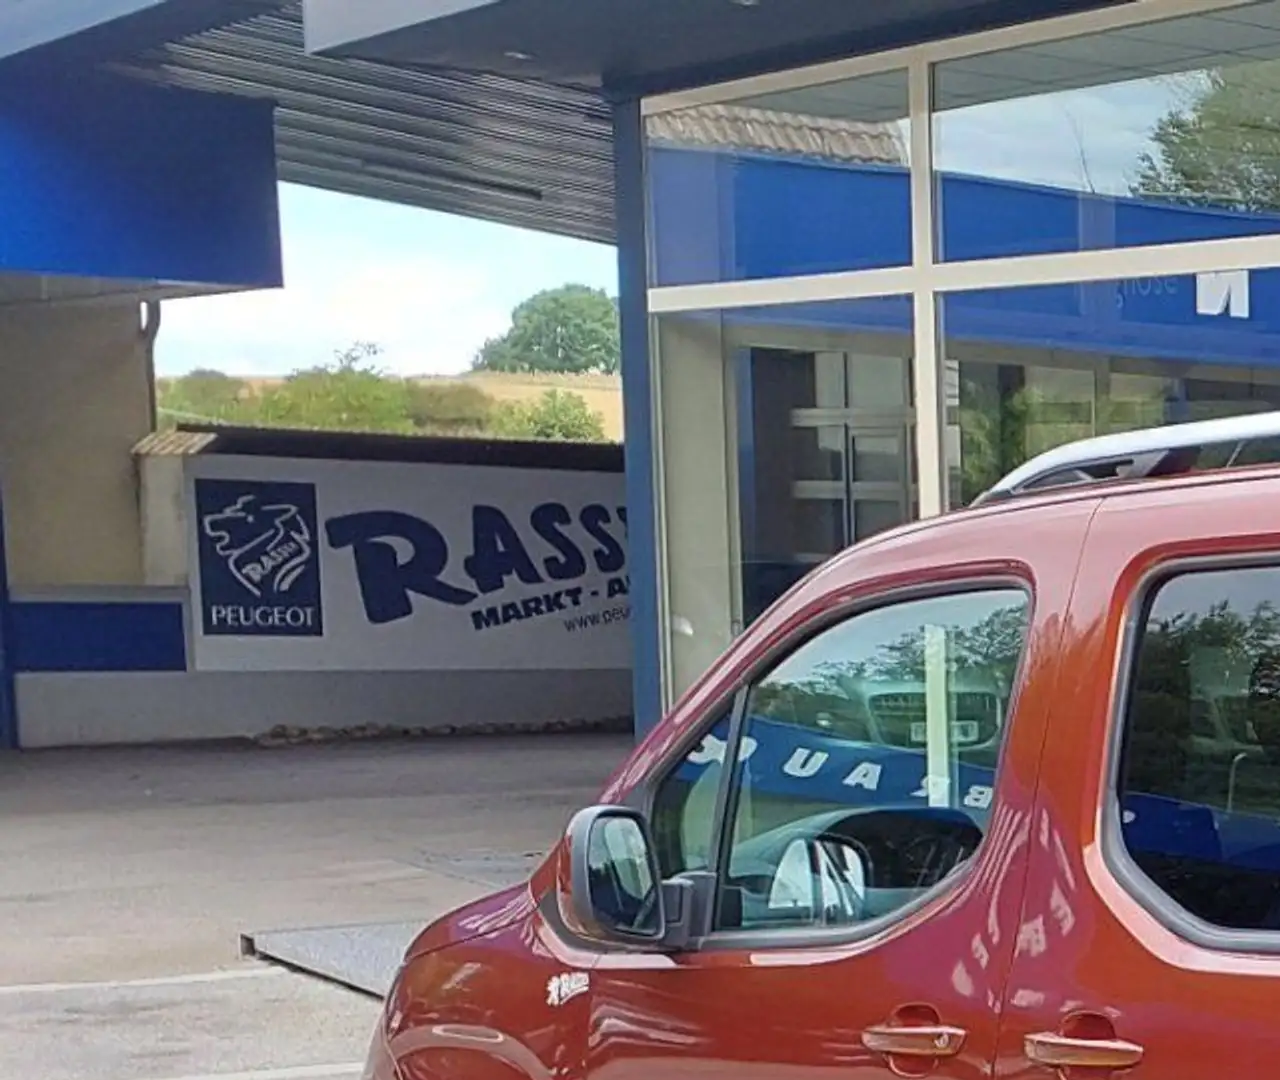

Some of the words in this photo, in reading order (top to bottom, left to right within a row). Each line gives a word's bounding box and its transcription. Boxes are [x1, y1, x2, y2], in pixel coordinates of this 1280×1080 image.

[325, 502, 628, 624] RASS
[211, 604, 315, 627] PEUGEOT
[471, 586, 583, 630] MARKT
[607, 575, 631, 600] A
